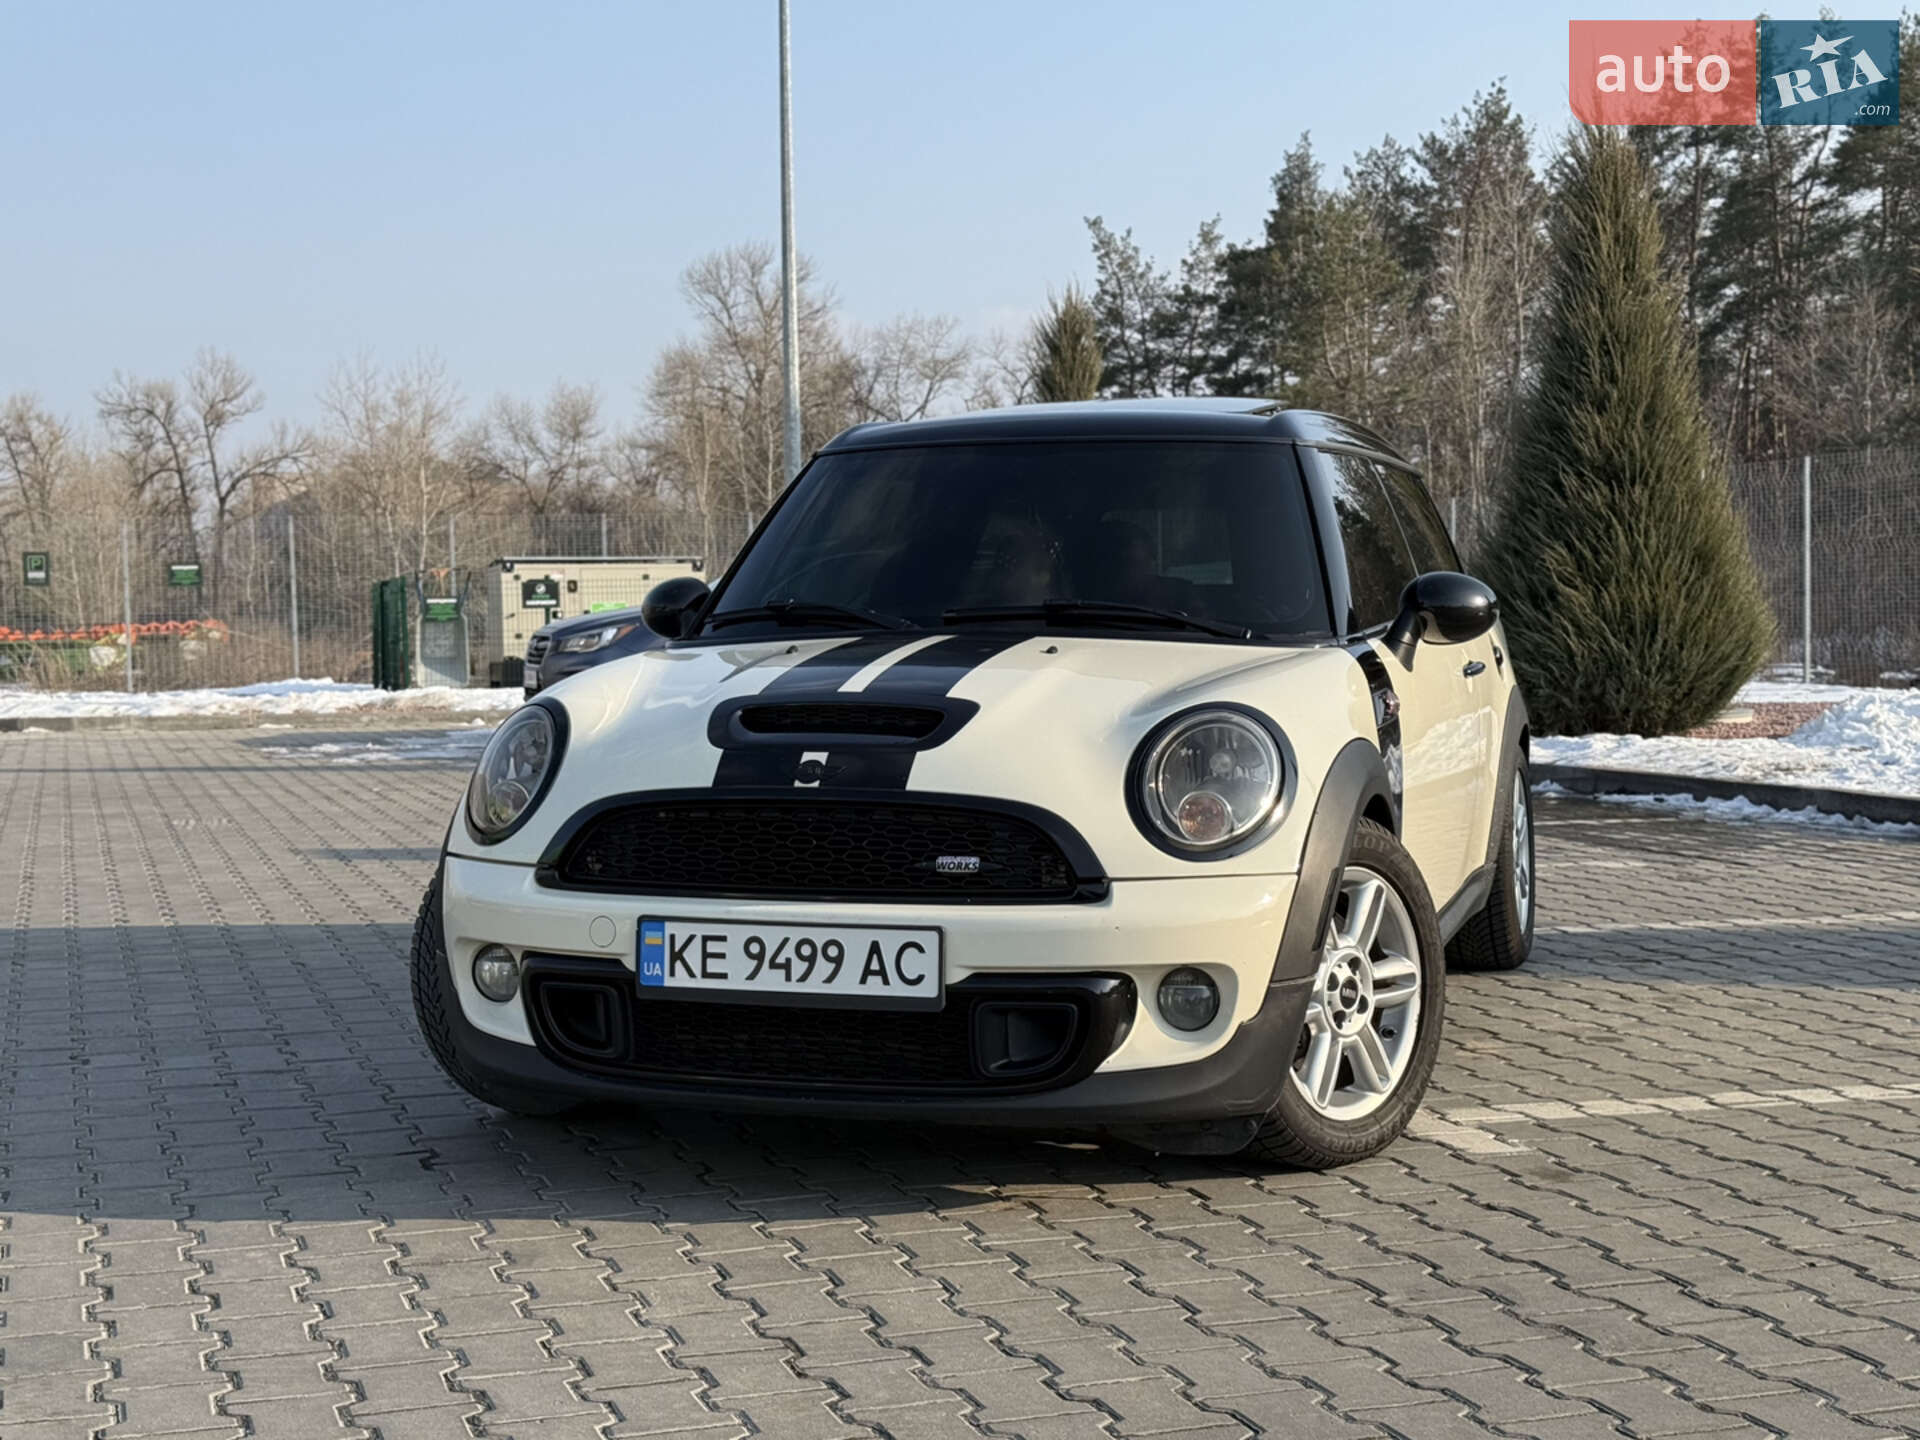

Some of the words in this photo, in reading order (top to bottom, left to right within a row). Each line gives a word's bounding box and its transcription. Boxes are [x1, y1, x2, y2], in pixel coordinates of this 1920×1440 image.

[936, 861, 979, 871] WORKS
[669, 933, 728, 980] KE
[743, 935, 845, 984] 9499
[859, 940, 926, 986] AC
[644, 962, 663, 977] UA
